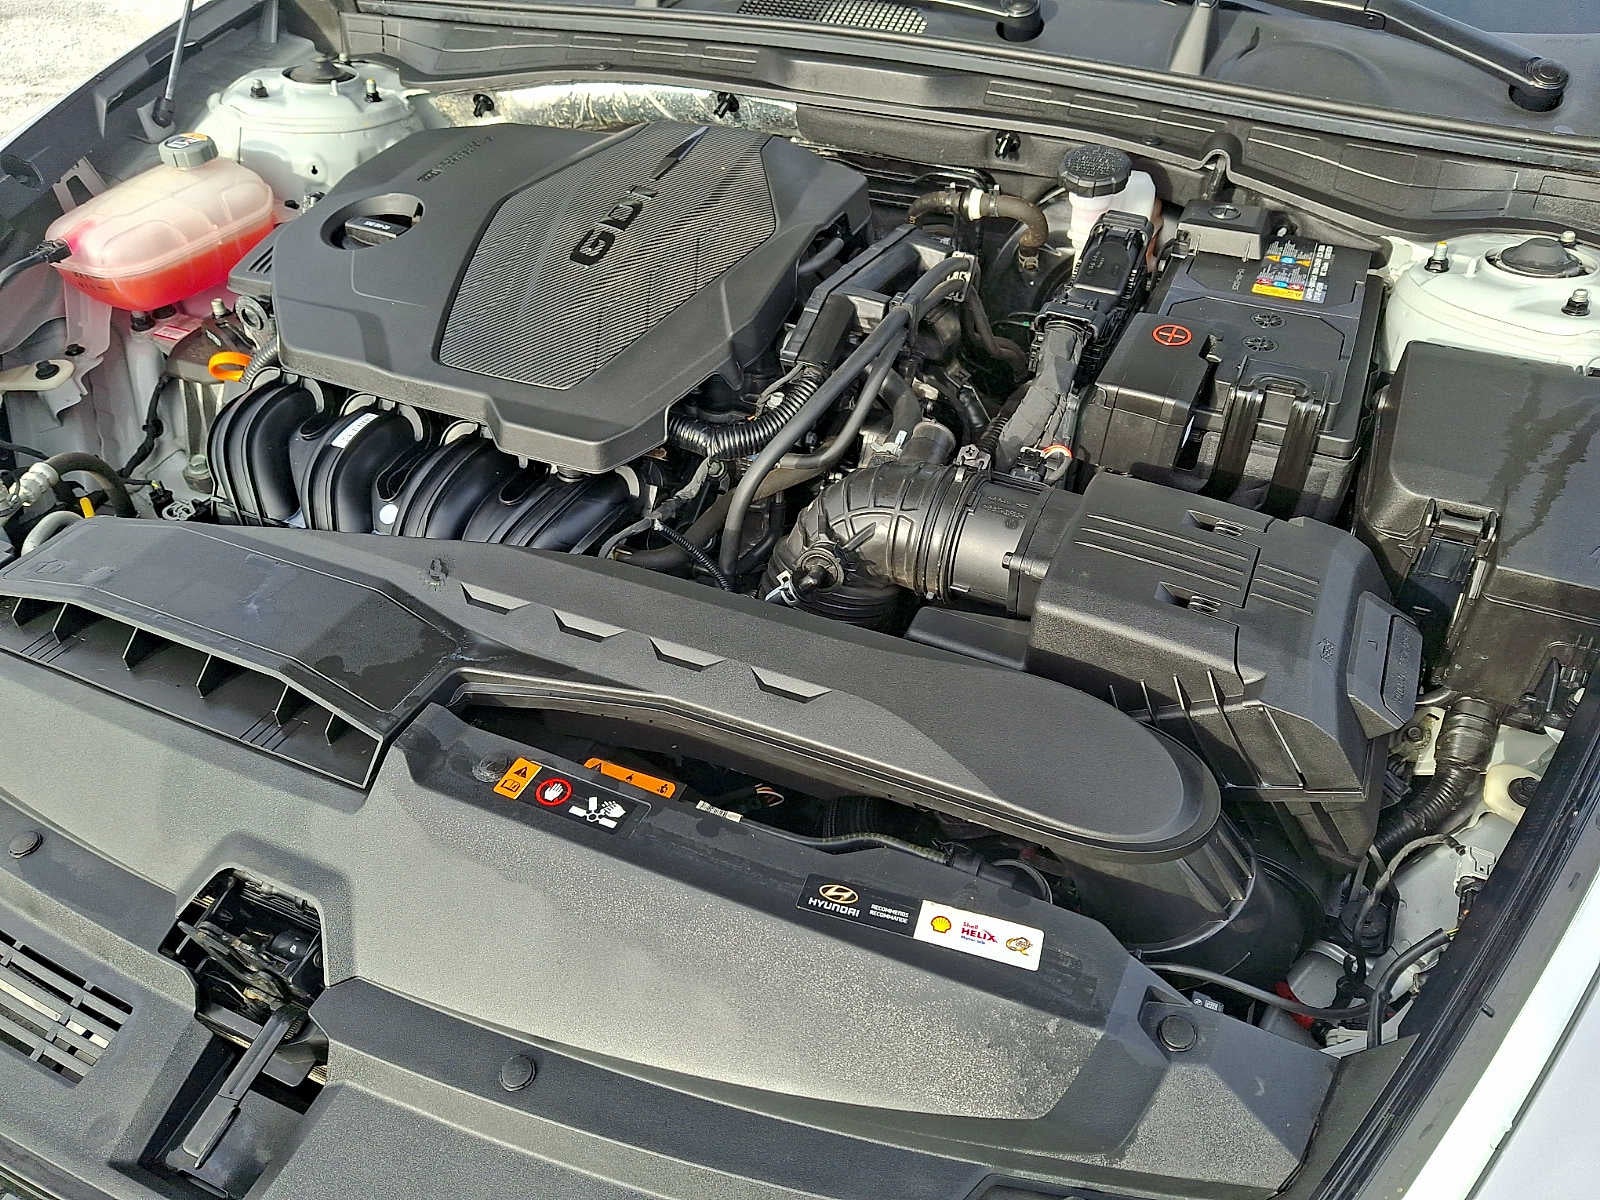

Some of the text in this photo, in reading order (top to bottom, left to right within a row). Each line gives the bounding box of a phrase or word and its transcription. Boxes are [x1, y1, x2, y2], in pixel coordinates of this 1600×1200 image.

[808, 897, 860, 918] HYUNDAI
[871, 903, 909, 918] RECOMMENDS
[869, 910, 908, 924] RECOMMANDE
[963, 921, 979, 930] Shell
[961, 927, 997, 943] HELIX
